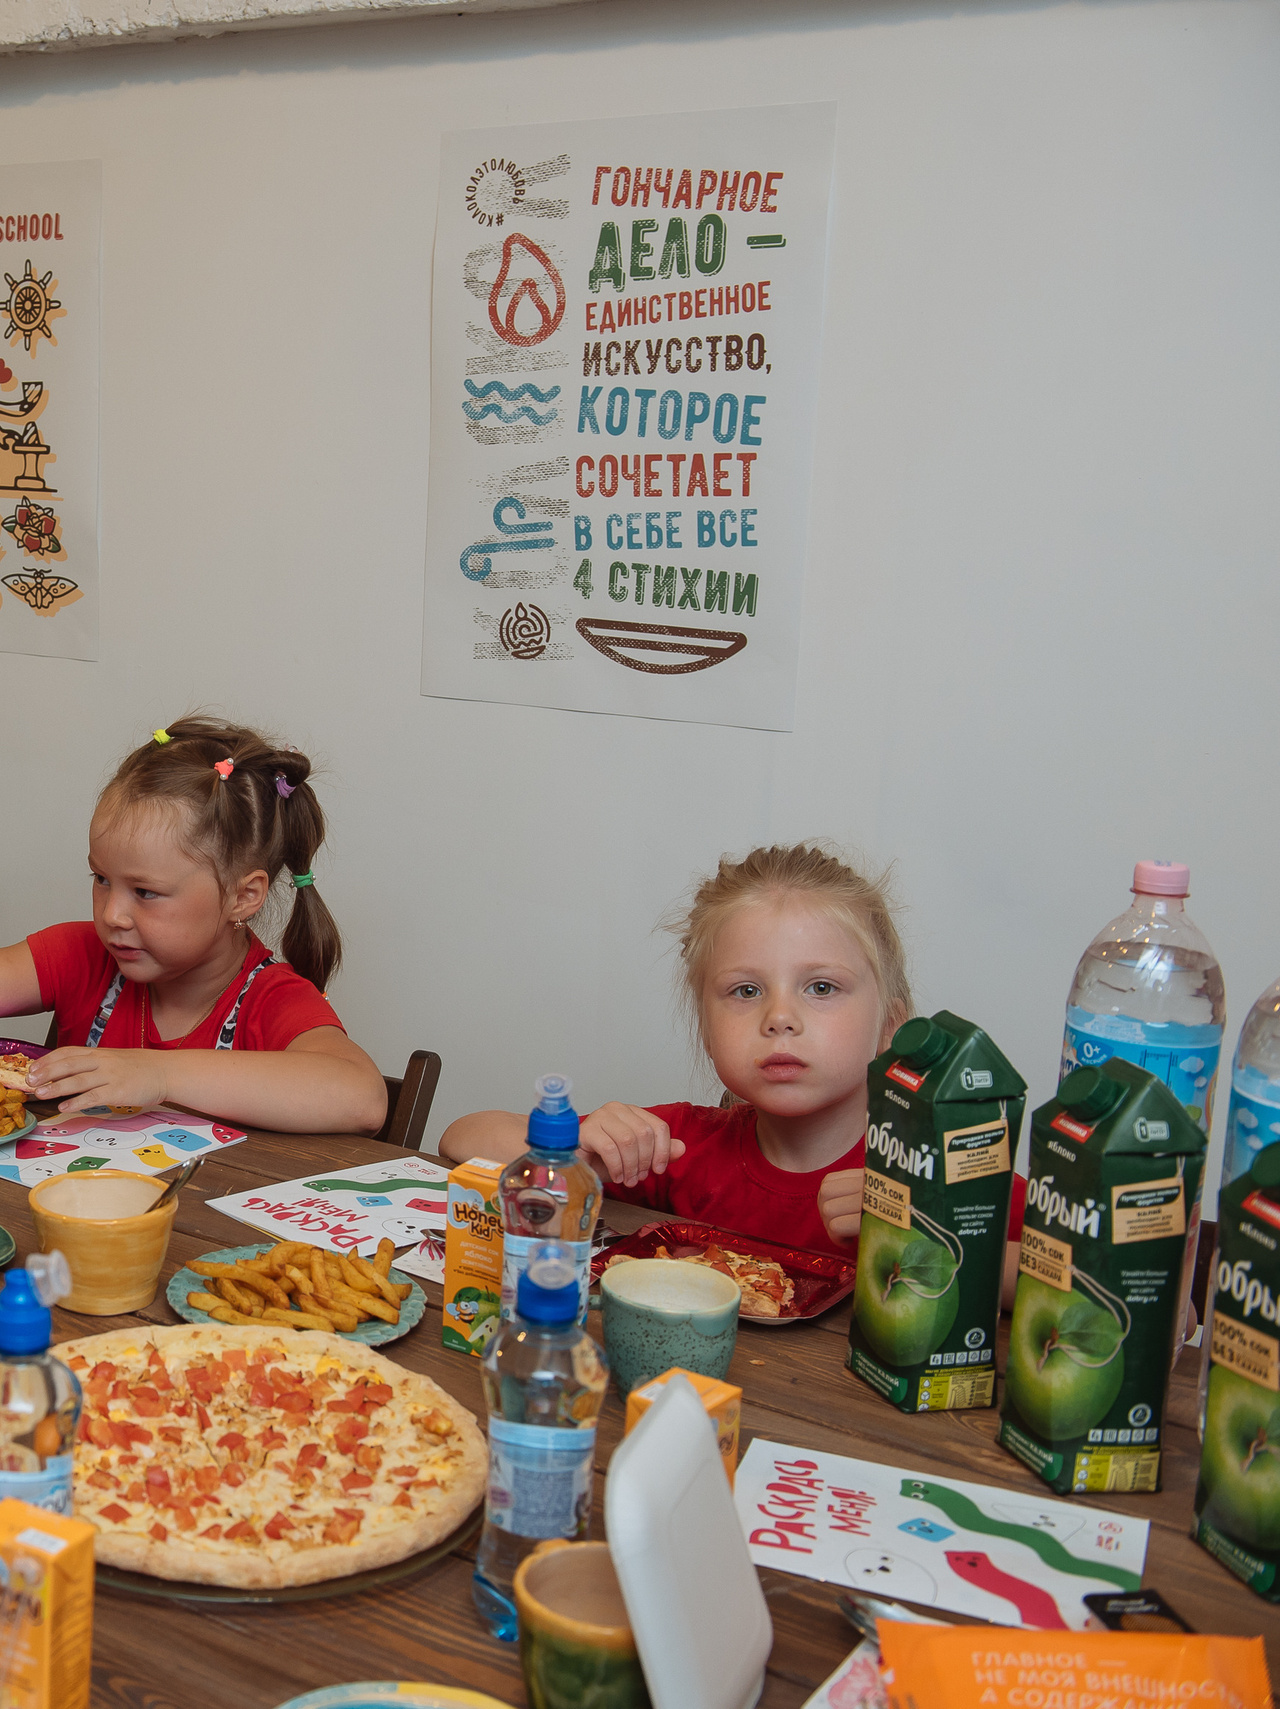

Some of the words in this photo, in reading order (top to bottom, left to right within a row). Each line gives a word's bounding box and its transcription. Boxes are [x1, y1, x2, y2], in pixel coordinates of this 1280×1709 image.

[591, 165, 784, 213] ГОНЧАРНОЕ
[589, 213, 728, 293] ДЕЛО
[585, 281, 772, 335] ЕДИНСТВЕННОЕ
[582, 333, 772, 378] ИСКУССТВО,
[577, 385, 767, 446] КОТОРОЕ
[575, 452, 757, 498] СОЧЕТАЕТ
[574, 515, 593, 551] В
[606, 511, 682, 550] СЕБЕ
[697, 508, 758, 549] ВСЕ
[572, 558, 594, 600] 4
[607, 561, 759, 617] СТИХИИ
[867, 1121, 935, 1181] обрый
[470, 1221, 490, 1238] Kid
[1026, 1175, 1101, 1239] обрый
[958, 1228, 987, 1236] dobry.ru
[1218, 1260, 1280, 1328] обры
[749, 1460, 824, 1554] РАСКРАСЬ
[970, 1651, 1088, 1669] ГЛАВНОЕ
[974, 1669, 1007, 1685] НЕ
[1017, 1670, 1077, 1688] МОЯ
[979, 1687, 998, 1704] А
